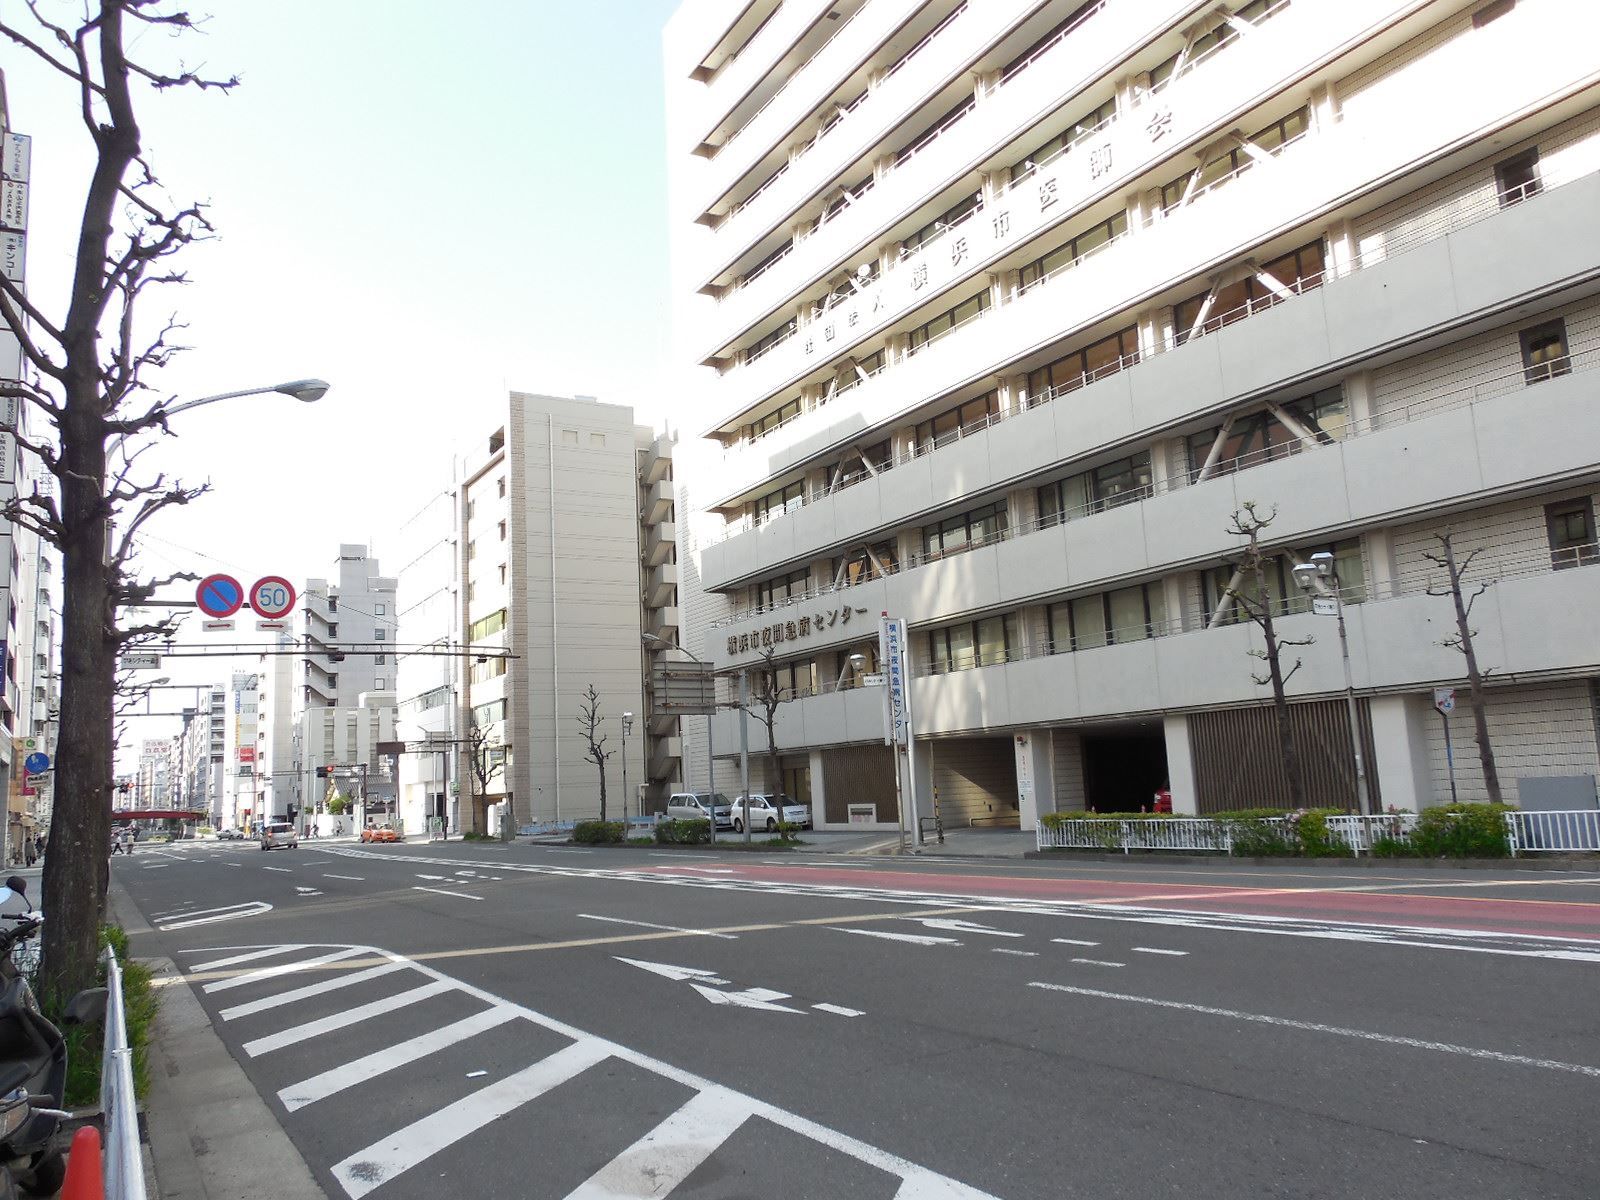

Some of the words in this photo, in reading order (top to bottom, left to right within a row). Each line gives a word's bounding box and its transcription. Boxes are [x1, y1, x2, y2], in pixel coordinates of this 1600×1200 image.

[259, 588, 286, 607] 50
[727, 604, 868, 656] 横浜市夜間急病センター
[888, 623, 902, 739] 横浜市夜間急病センター
